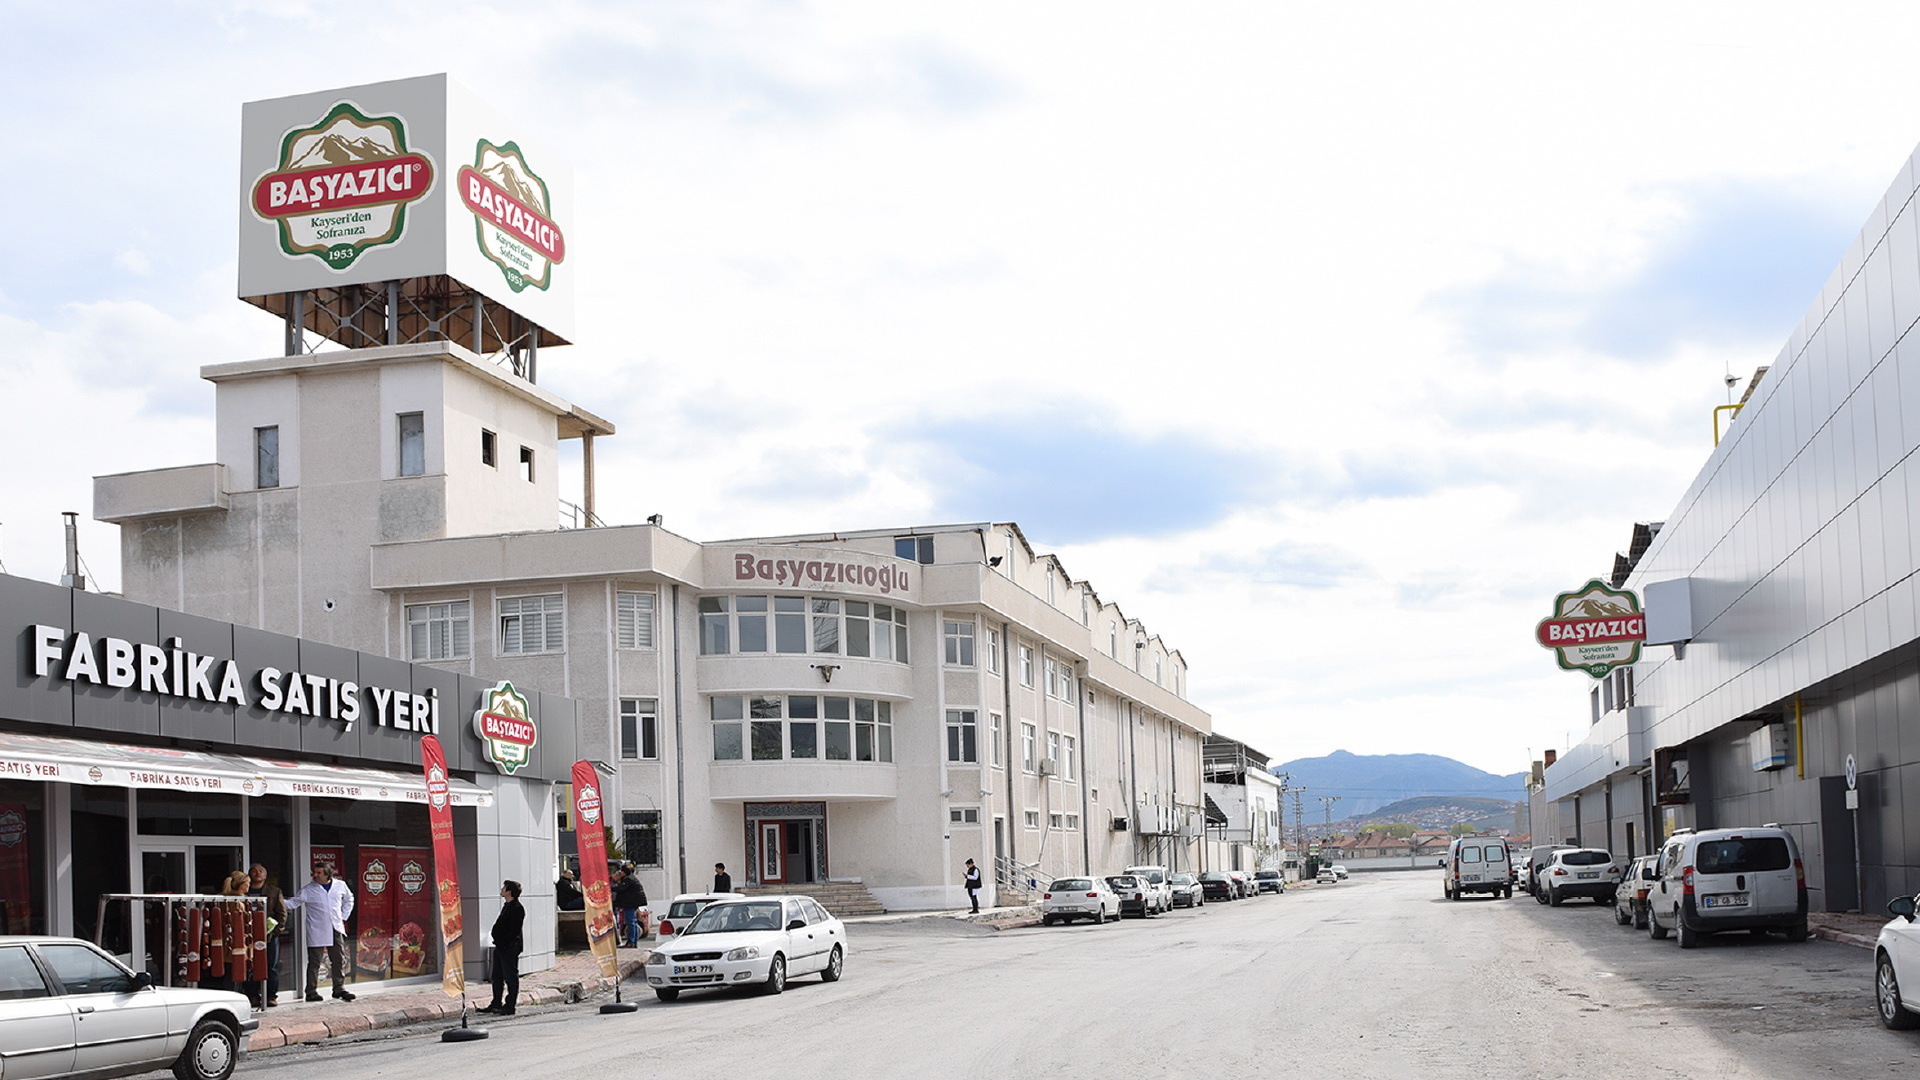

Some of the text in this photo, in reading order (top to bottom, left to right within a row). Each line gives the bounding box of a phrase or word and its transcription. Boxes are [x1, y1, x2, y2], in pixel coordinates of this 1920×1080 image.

[311, 212, 372, 228] Kayseri'den
[328, 248, 354, 260] 1953
[734, 553, 909, 593] Başyazıcıoğlu
[1549, 619, 1643, 642] BAŞYAZICI
[35, 624, 440, 735] FABRİKA SATIŞ YERİ
[34, 763, 60, 776] YERİ
[130, 772, 171, 785] FABRİKA
[201, 776, 222, 788] YERİ
